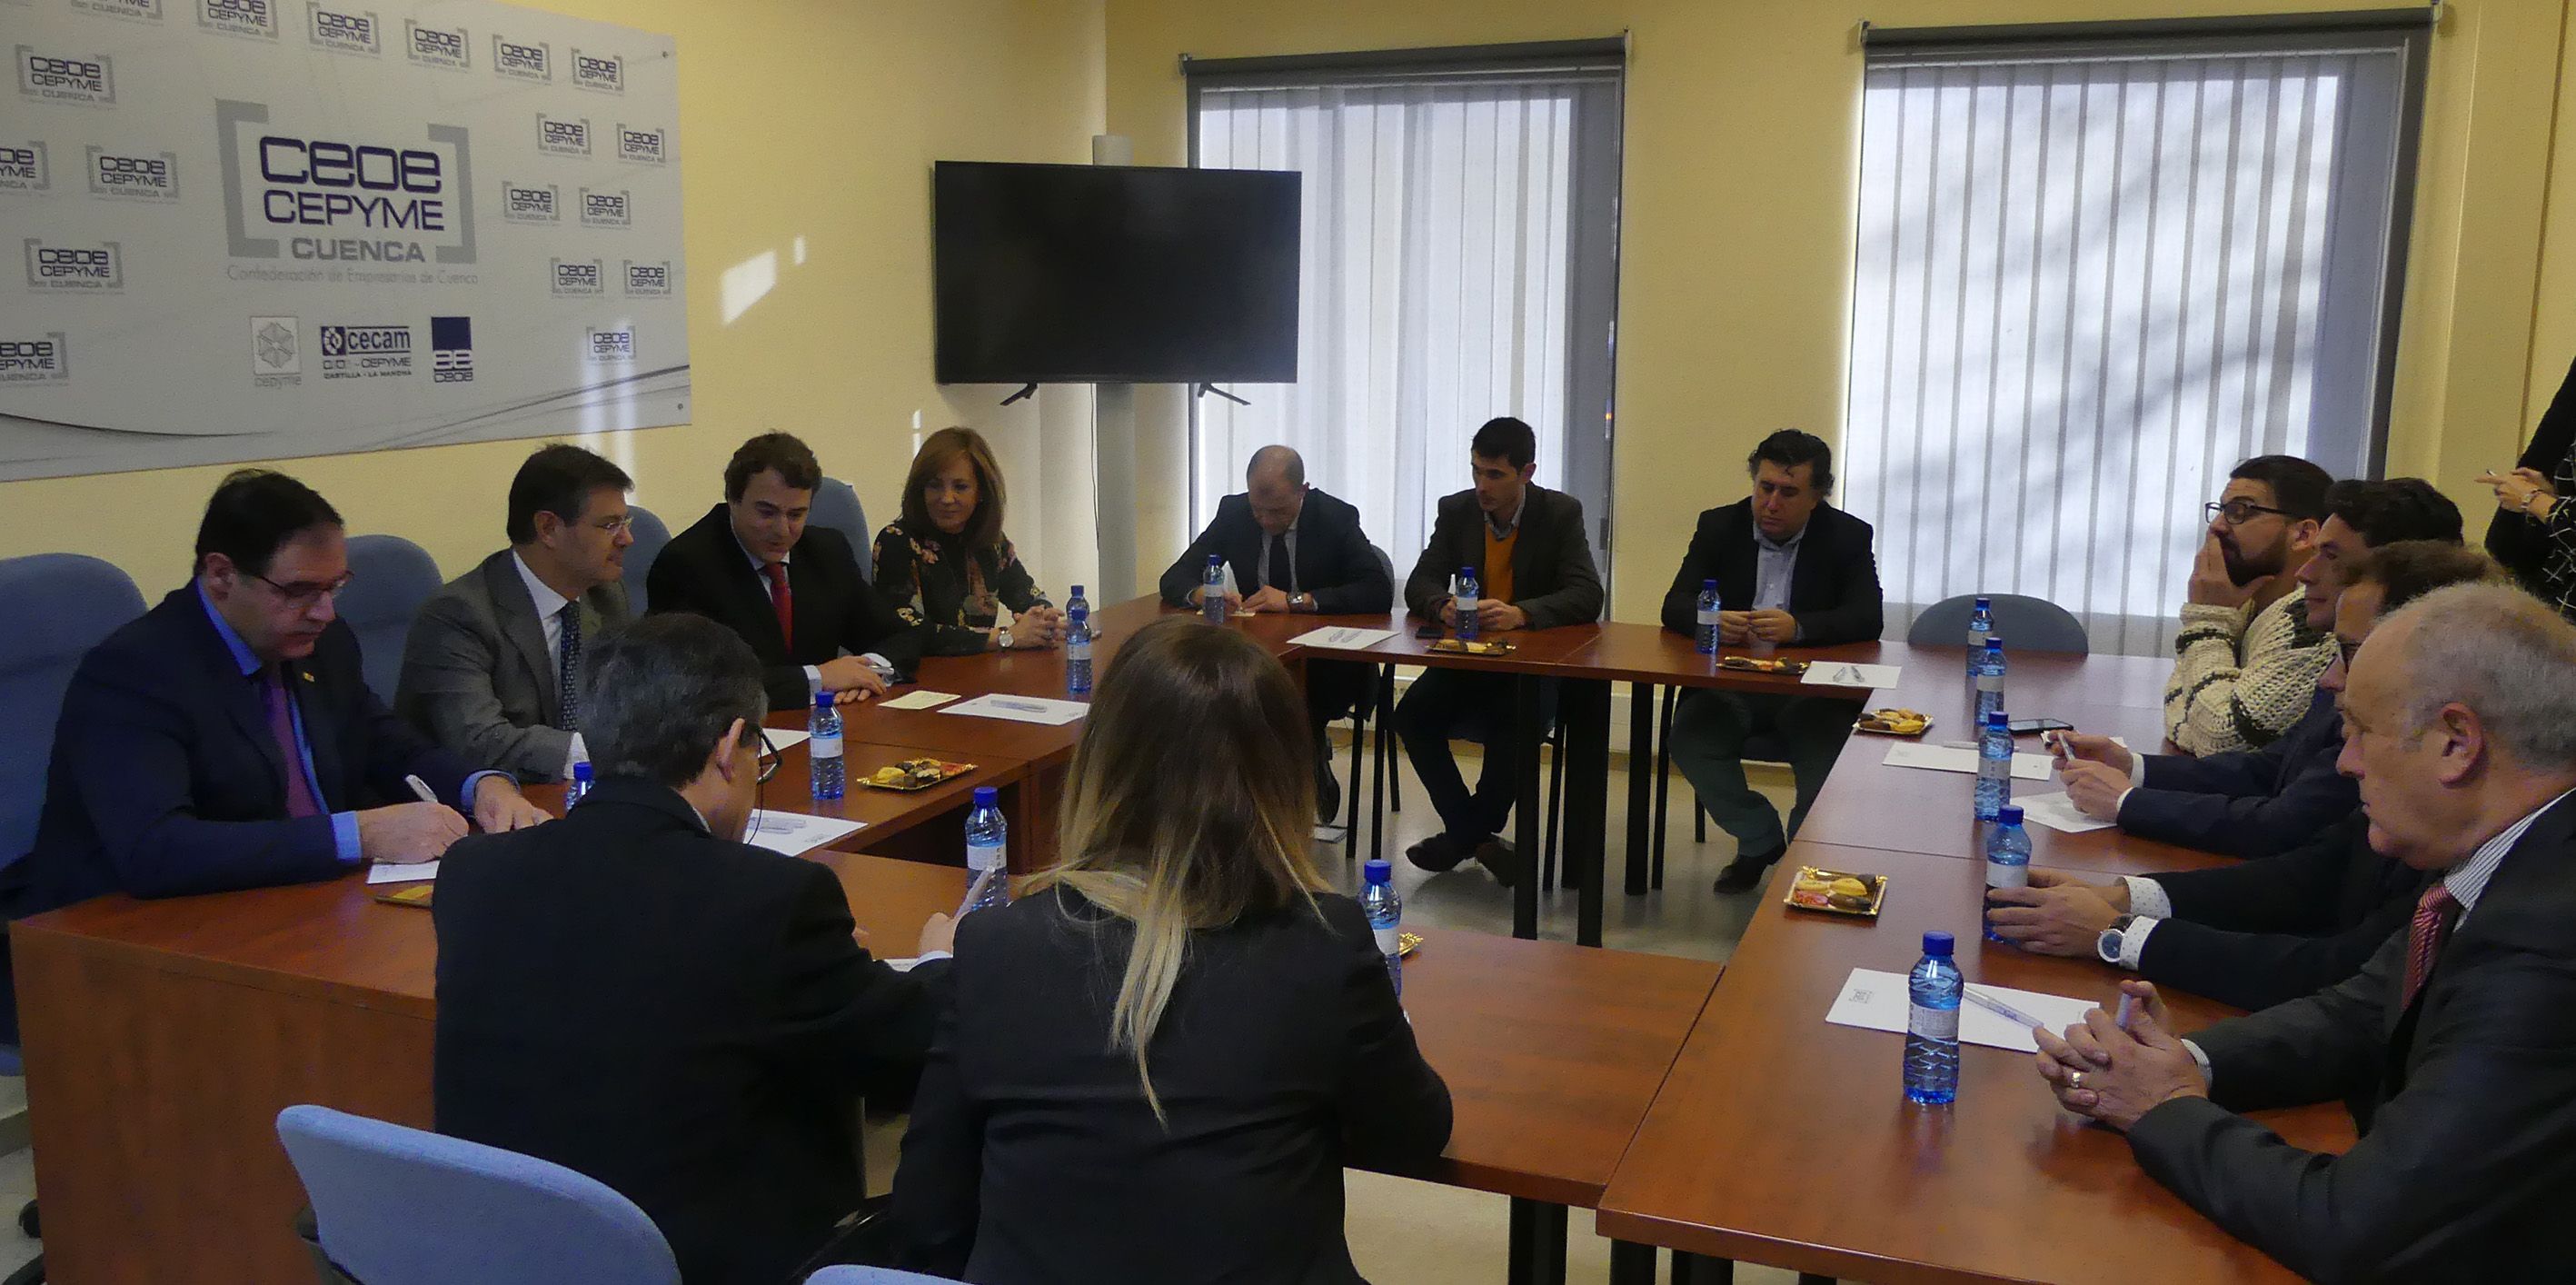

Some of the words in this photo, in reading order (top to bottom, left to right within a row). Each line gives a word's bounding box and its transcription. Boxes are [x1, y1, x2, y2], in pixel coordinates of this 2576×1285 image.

[208, 8, 267, 27] CEPYME
[319, 26, 371, 44] CEPYME
[415, 42, 462, 58] CEPYME
[502, 56, 543, 71] CEPYME
[32, 73, 103, 92] CEPYME
[579, 69, 618, 83] CEPYME
[545, 134, 584, 146] CEPYME
[624, 144, 660, 155] CEPYME
[0, 165, 36, 178] YME
[260, 136, 442, 194] ceoe
[101, 173, 167, 187] CEPYME
[264, 189, 444, 231] CEPYME
[512, 202, 552, 214] CEPYME
[587, 206, 624, 217] CEPYME
[291, 237, 426, 263] CUENCA
[40, 265, 110, 278] CEPYME
[558, 277, 597, 286] CEPYME
[631, 278, 665, 287] CEPYME
[348, 330, 411, 350] cecam
[0, 342, 53, 357] eoe
[593, 344, 630, 354] CEPYME
[0, 358, 55, 370] EPYME
[362, 358, 412, 369] CEPYME
